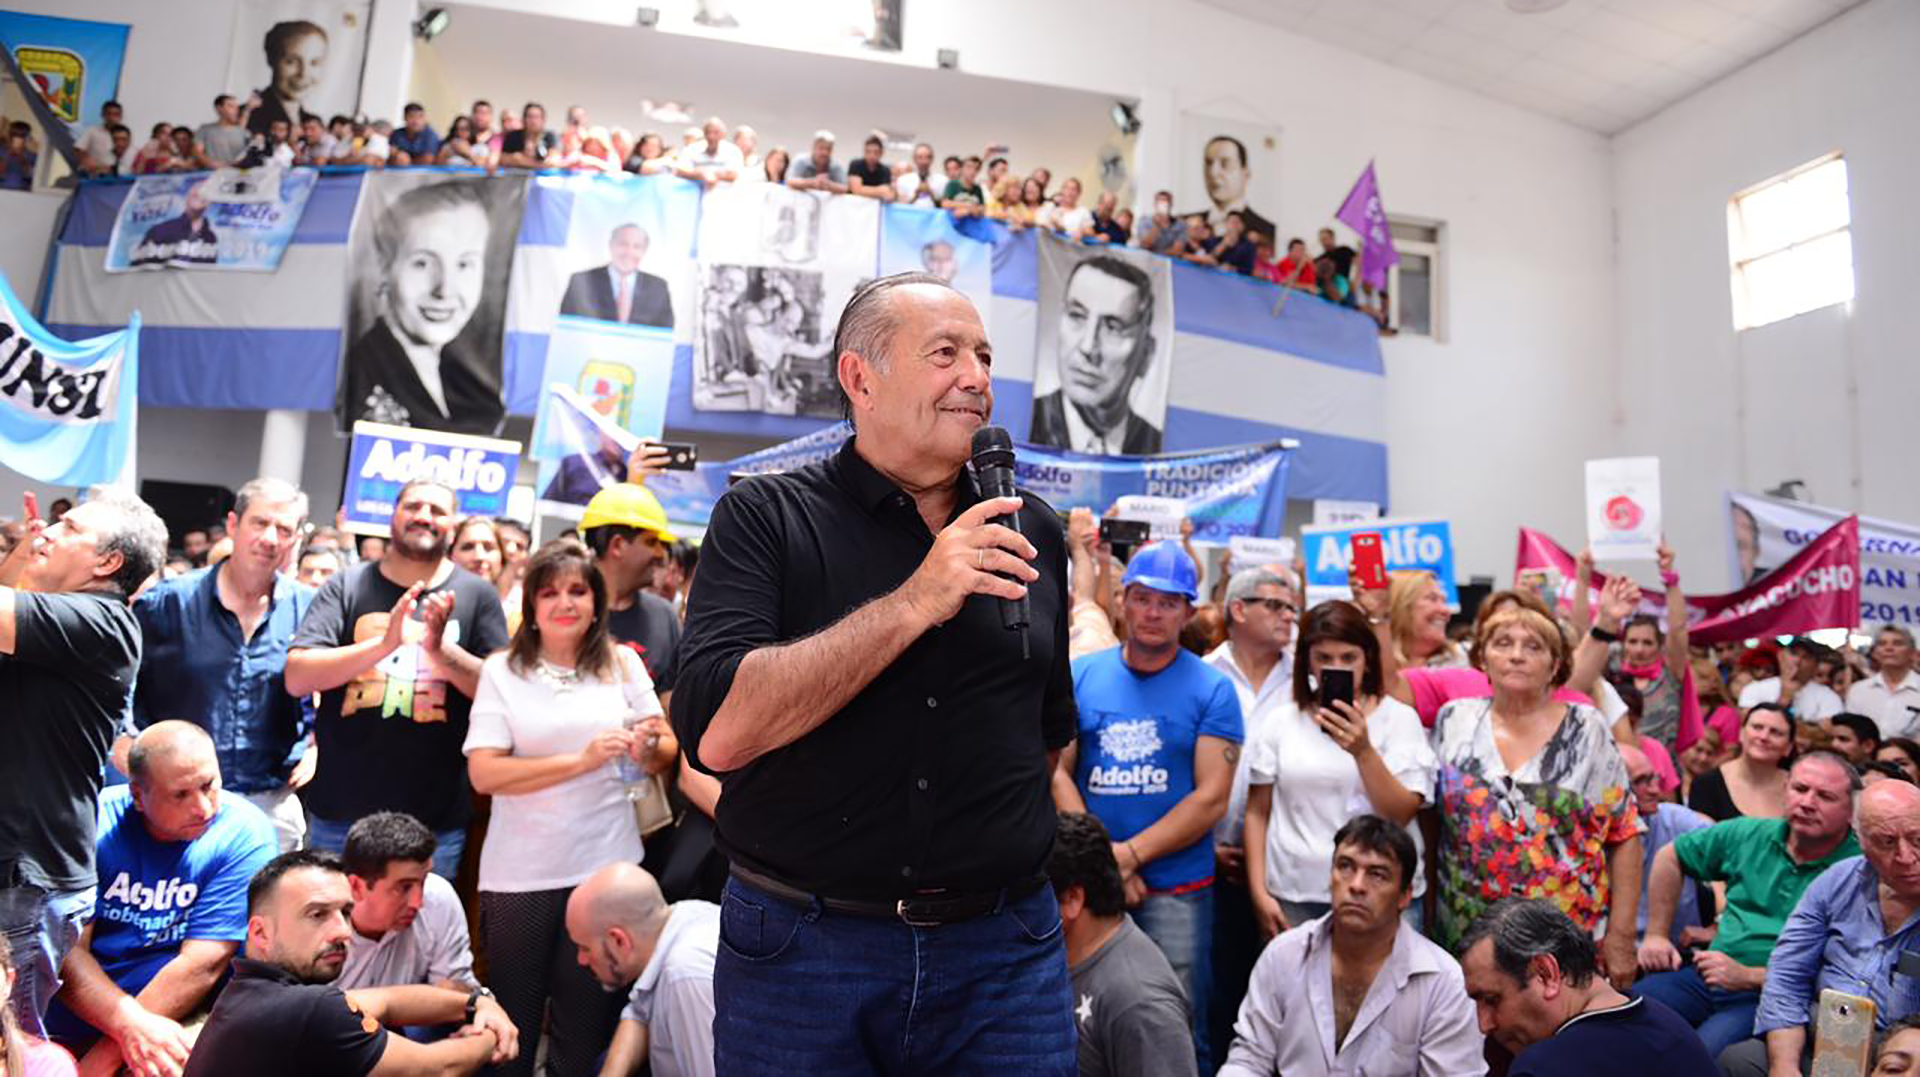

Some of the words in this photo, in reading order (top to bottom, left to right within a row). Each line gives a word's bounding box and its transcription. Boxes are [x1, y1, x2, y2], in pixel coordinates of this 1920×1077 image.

[360, 439, 506, 493] Adolfo
[1317, 526, 1443, 572] Alfo
[1089, 765, 1168, 785] Adolfo
